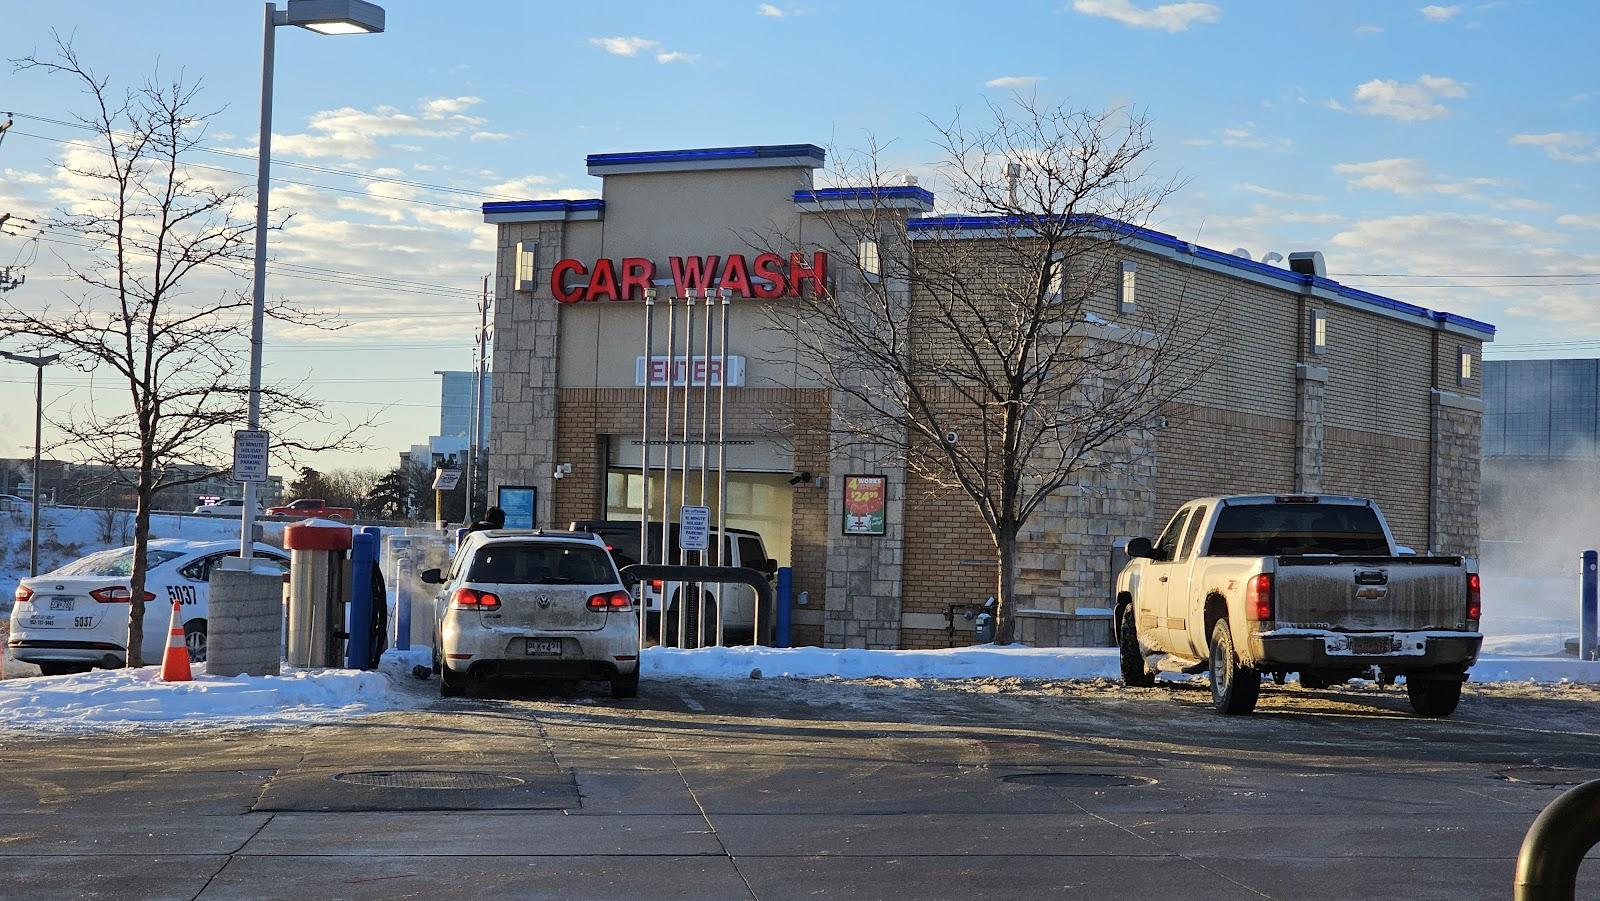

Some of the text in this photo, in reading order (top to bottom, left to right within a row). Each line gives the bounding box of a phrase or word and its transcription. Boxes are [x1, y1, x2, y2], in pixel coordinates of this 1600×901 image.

[551, 251, 828, 303] CAR WASH
[650, 360, 724, 381] ENTER
[166, 585, 197, 606] 5037
[74, 616, 93, 628] 5037
